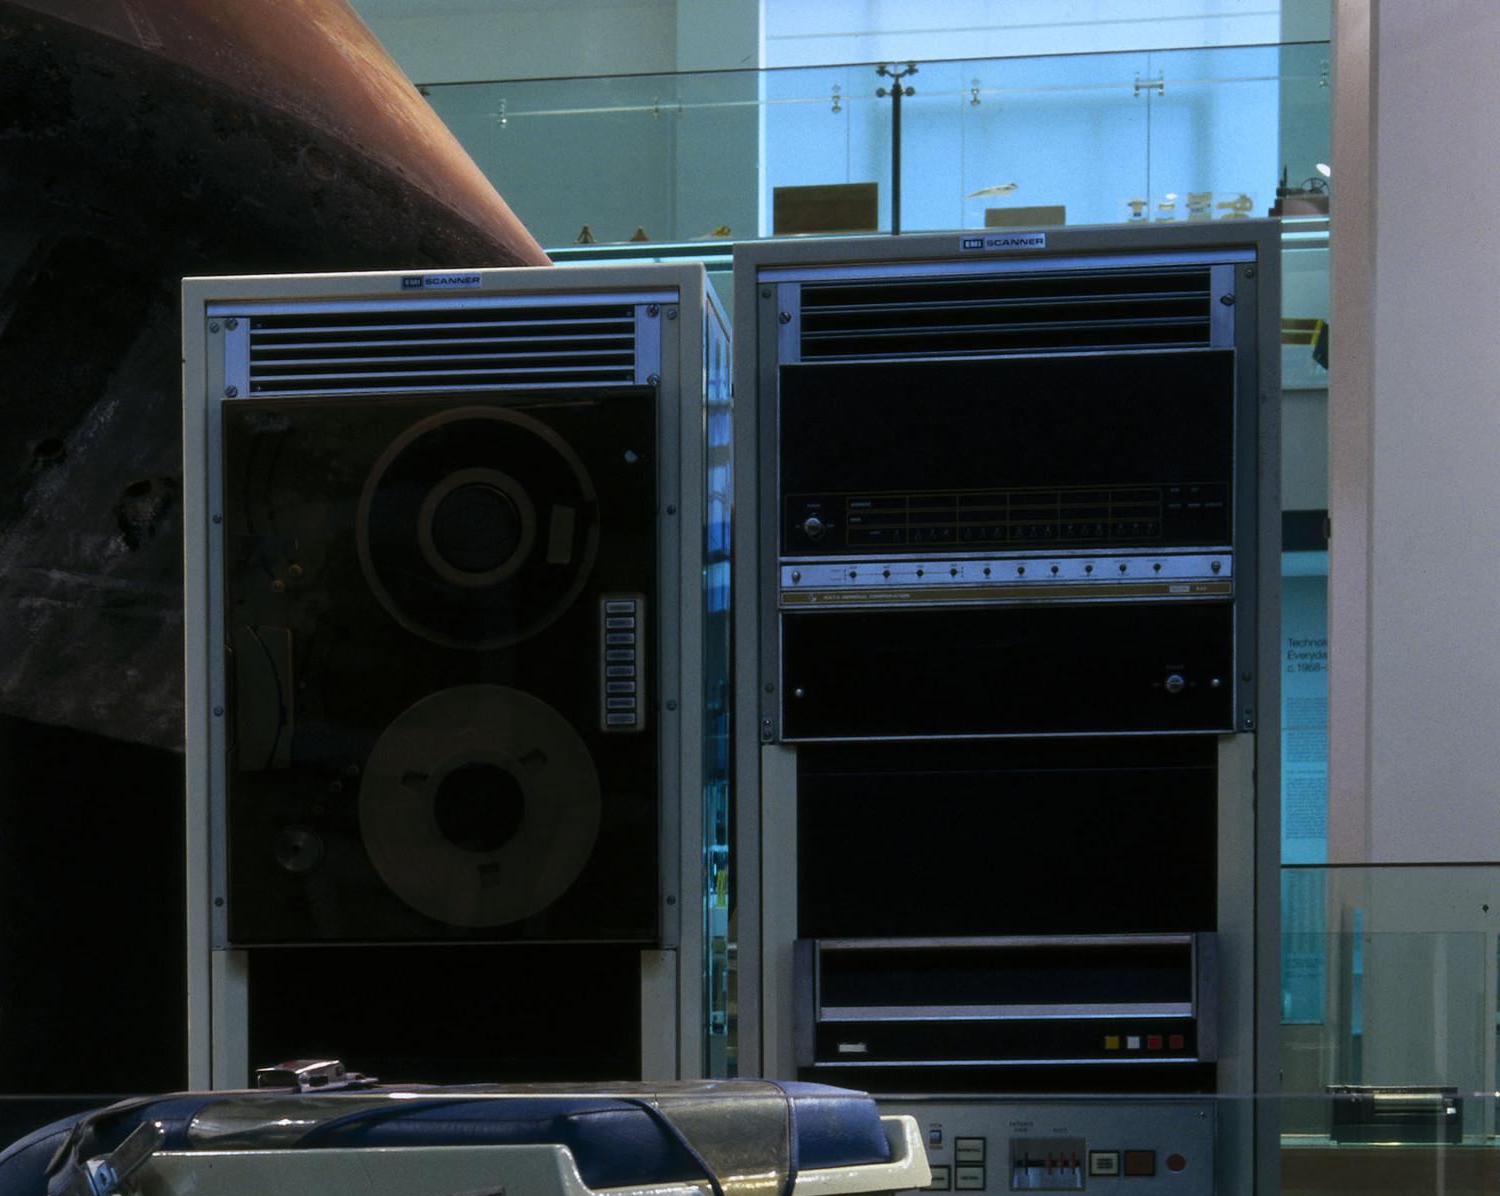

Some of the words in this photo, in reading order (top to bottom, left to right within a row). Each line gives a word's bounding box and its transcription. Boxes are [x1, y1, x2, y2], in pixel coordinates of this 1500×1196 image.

[964, 240, 983, 249] EMI
[987, 237, 1043, 247] SCANNER
[425, 276, 480, 286] SCANNER
